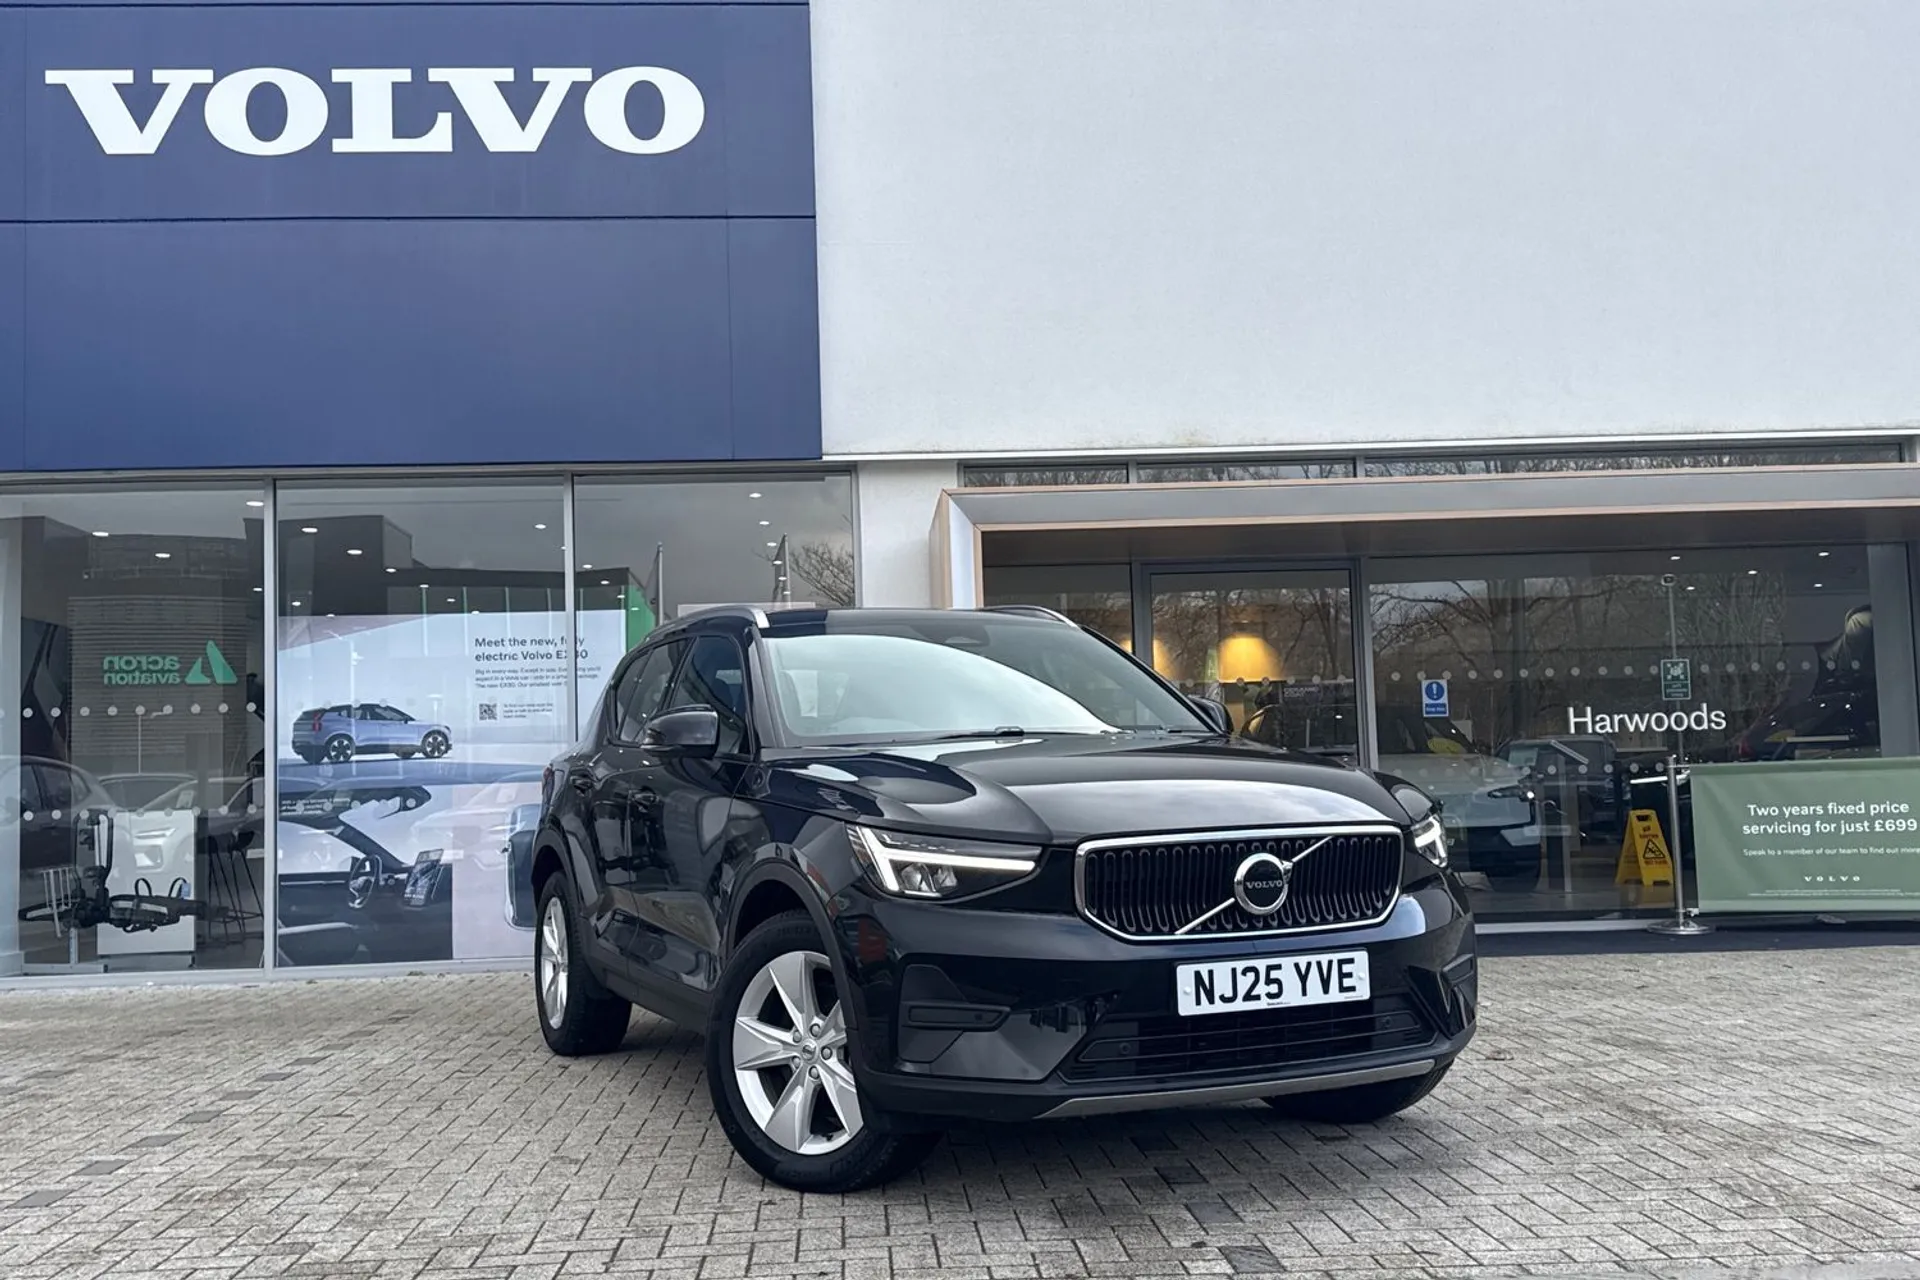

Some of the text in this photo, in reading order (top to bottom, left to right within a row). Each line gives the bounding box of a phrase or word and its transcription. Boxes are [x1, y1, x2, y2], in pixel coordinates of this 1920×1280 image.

[45, 65, 706, 156] VOLVO
[475, 638, 506, 648] Meet
[508, 637, 527, 647] the
[530, 638, 558, 648] new,
[475, 649, 588, 662] electric Volvo E0
[1567, 703, 1727, 734] Harwoods
[1747, 800, 1910, 818] Two years fixed price
[1743, 818, 1918, 836] servicing for just £699
[1743, 849, 1766, 857] Speak
[1815, 847, 1823, 855] of
[1245, 879, 1283, 889] VOLVO
[1194, 957, 1357, 1007] NJ25 YVE
